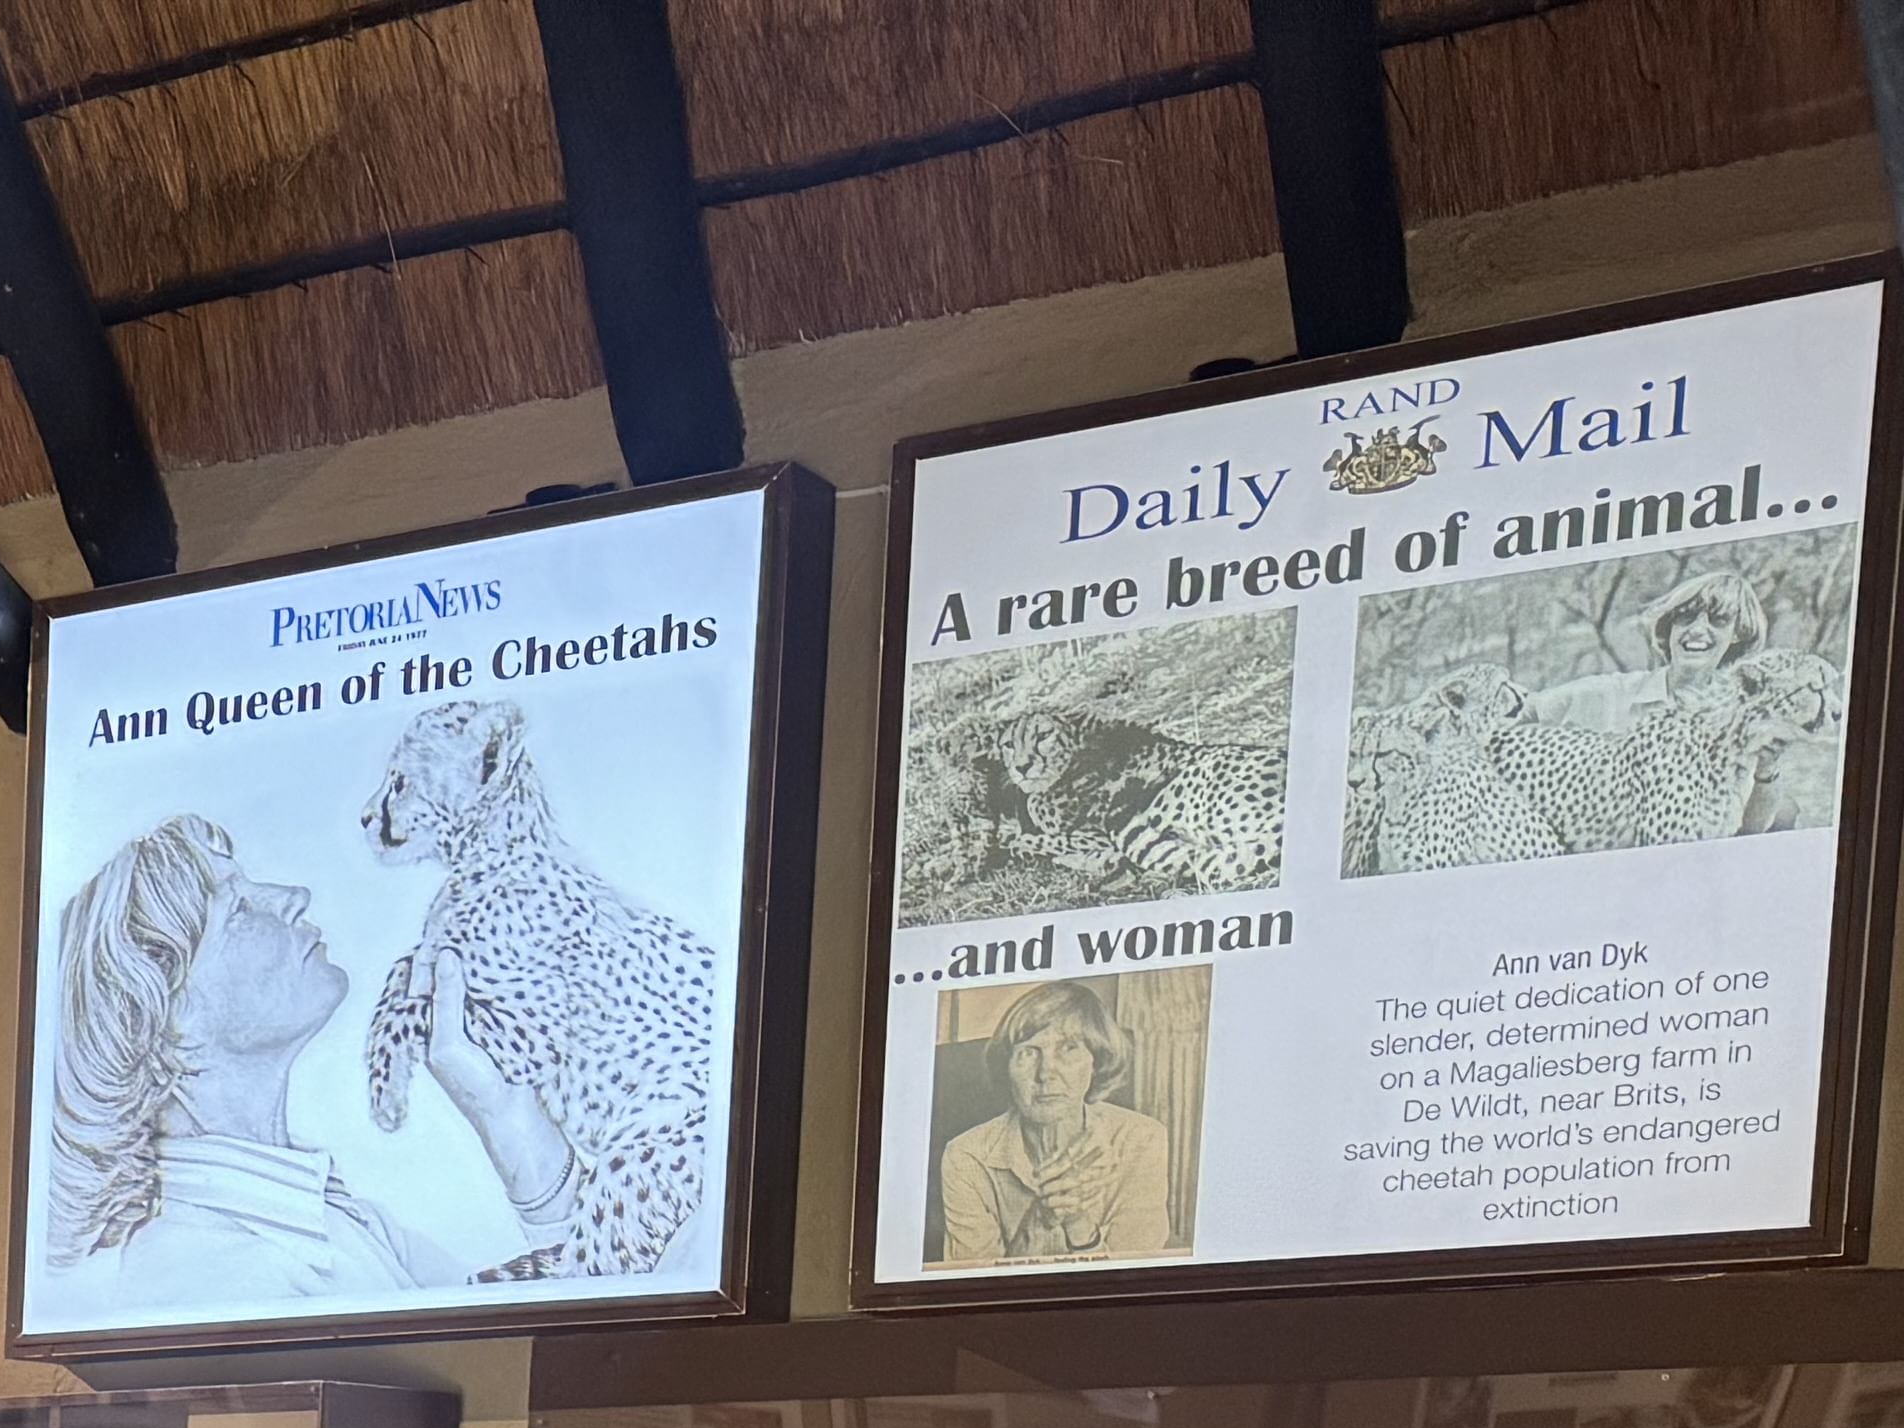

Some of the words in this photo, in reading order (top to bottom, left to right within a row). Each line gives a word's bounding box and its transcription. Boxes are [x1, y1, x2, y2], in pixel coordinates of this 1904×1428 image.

[1320, 378, 1460, 424] RAND
[1059, 462, 1290, 543] Daily
[1474, 375, 1690, 469] Mail
[930, 592, 971, 646] A
[997, 578, 1137, 635] rare
[1166, 527, 1365, 610] breed
[1394, 511, 1469, 573] of
[1493, 468, 1837, 559] animal...
[88, 707, 167, 747] Ann
[186, 681, 321, 734] Queen
[341, 661, 385, 704] of
[400, 653, 472, 695] the
[492, 614, 716, 680] Cheetahs
[894, 924, 1054, 984] ...and
[1076, 910, 1292, 965] woman
[1492, 953, 1539, 976] Ann
[1549, 950, 1591, 971] van
[1601, 940, 1647, 970] Dyk
[1375, 997, 1427, 1022] The
[1436, 989, 1505, 1018] quiet
[1515, 977, 1663, 1009] dedication
[1674, 970, 1704, 995] of
[1712, 970, 1768, 992] one
[1369, 1028, 1473, 1056] slender,
[1486, 1011, 1648, 1047] determined
[1659, 1007, 1768, 1032] woman
[1379, 1071, 1413, 1090] on
[1423, 1068, 1440, 1086] a
[1450, 1051, 1640, 1087] Magaliesberg
[1652, 1045, 1716, 1069] farm
[1728, 1039, 1751, 1063] in
[1403, 1099, 1440, 1122] De
[1450, 1092, 1528, 1118] Wildt,
[1540, 1090, 1604, 1113] near
[1613, 1082, 1685, 1107] Brits,
[1699, 1078, 1720, 1101] is
[1343, 1135, 1429, 1161] saving
[1441, 1130, 1483, 1154] the
[1492, 1122, 1592, 1150] world's
[1603, 1110, 1780, 1143] endangered
[1382, 1163, 1492, 1192] cheetah
[1503, 1155, 1653, 1190] population
[1666, 1152, 1729, 1174] from
[1483, 1192, 1617, 1220] extinction
